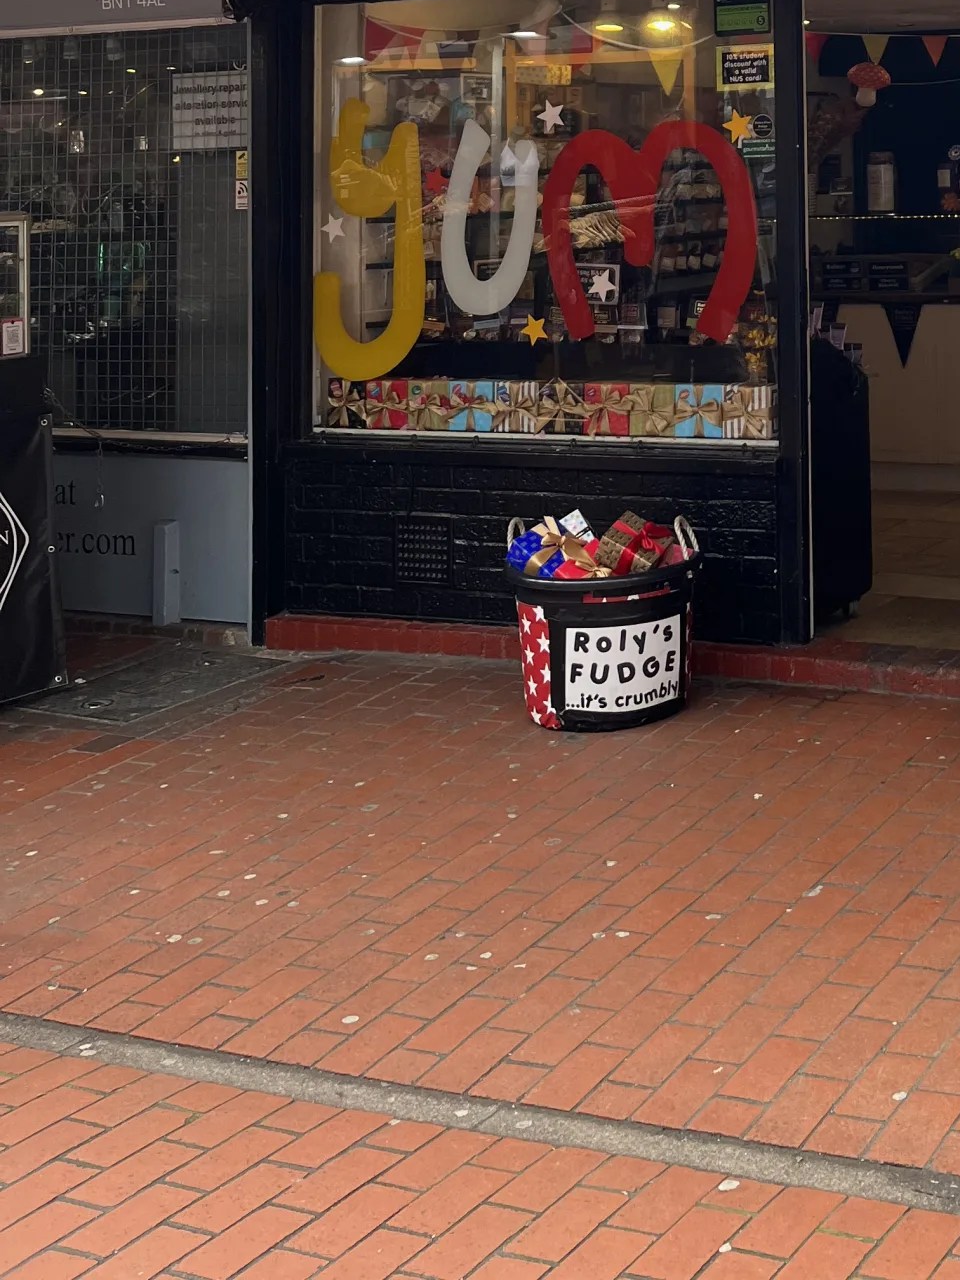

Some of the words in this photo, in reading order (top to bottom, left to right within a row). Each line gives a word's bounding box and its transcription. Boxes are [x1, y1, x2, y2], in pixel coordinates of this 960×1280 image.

[739, 52, 765, 60] student
[194, 115, 236, 125] available
[54, 479, 77, 505] at
[573, 623, 674, 654] Roly's
[569, 650, 677, 685] FUDGE
[614, 680, 679, 708] crumbly
